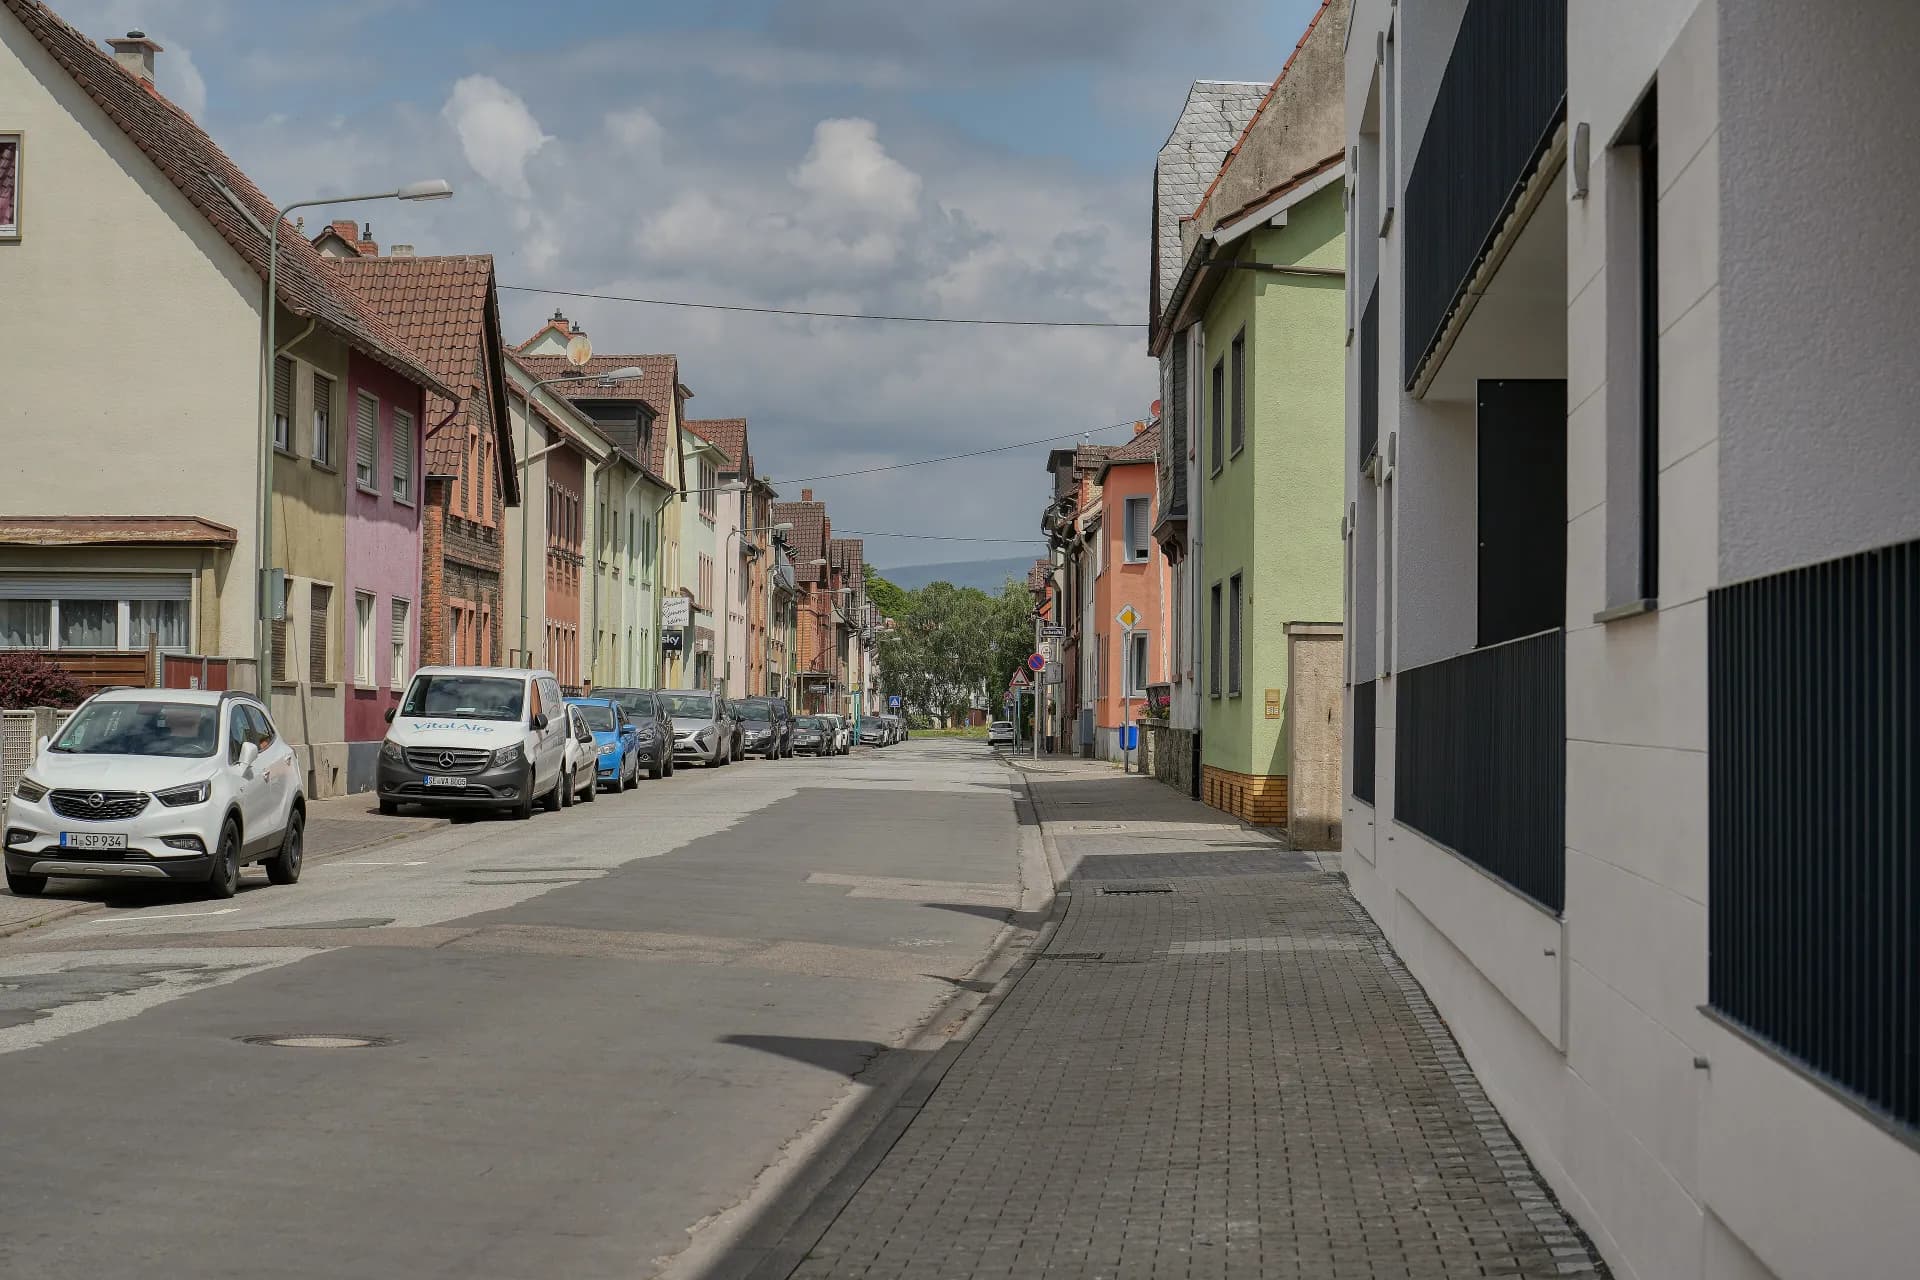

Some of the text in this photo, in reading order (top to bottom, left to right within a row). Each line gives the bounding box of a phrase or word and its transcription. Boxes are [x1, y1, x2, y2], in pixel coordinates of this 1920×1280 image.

[662, 634, 680, 646] sky
[71, 835, 121, 846] H SP 934
